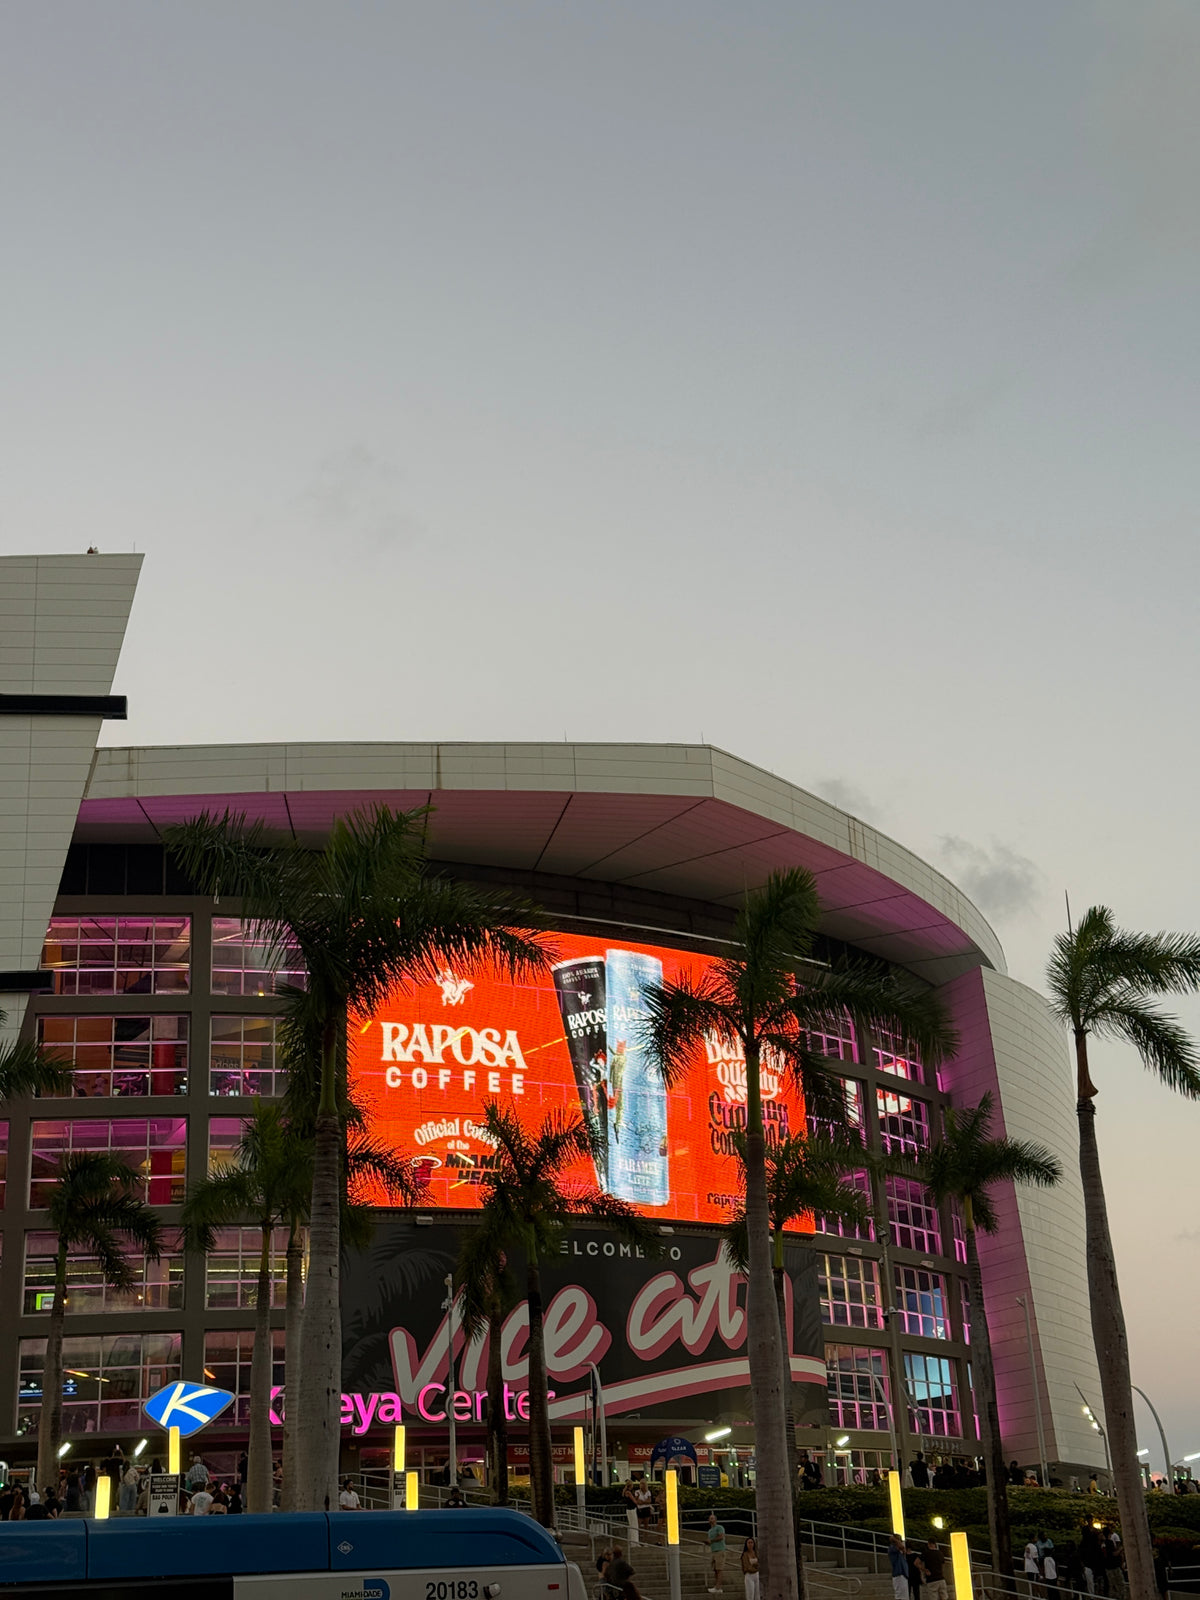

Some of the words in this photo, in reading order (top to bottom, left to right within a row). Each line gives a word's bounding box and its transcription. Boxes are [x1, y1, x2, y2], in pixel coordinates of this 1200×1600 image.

[571, 1025, 607, 1039] COFFE
[380, 1022, 529, 1069] RAPOSA
[386, 1066, 525, 1095] COFFEE
[717, 1061, 782, 1103] quaity.
[414, 1118, 460, 1146] Official
[447, 1140, 455, 1150] of
[456, 1140, 470, 1150] the
[445, 1154, 501, 1168] MIAMI
[458, 1170, 501, 1185] HEA
[541, 1240, 645, 1258] ELCOME
[160, 1382, 220, 1427] K
[268, 1385, 402, 1435] Keya
[418, 1382, 556, 1423] Cente
[634, 1447, 653, 1456] SEAS
[426, 1580, 478, 1600] 20183
